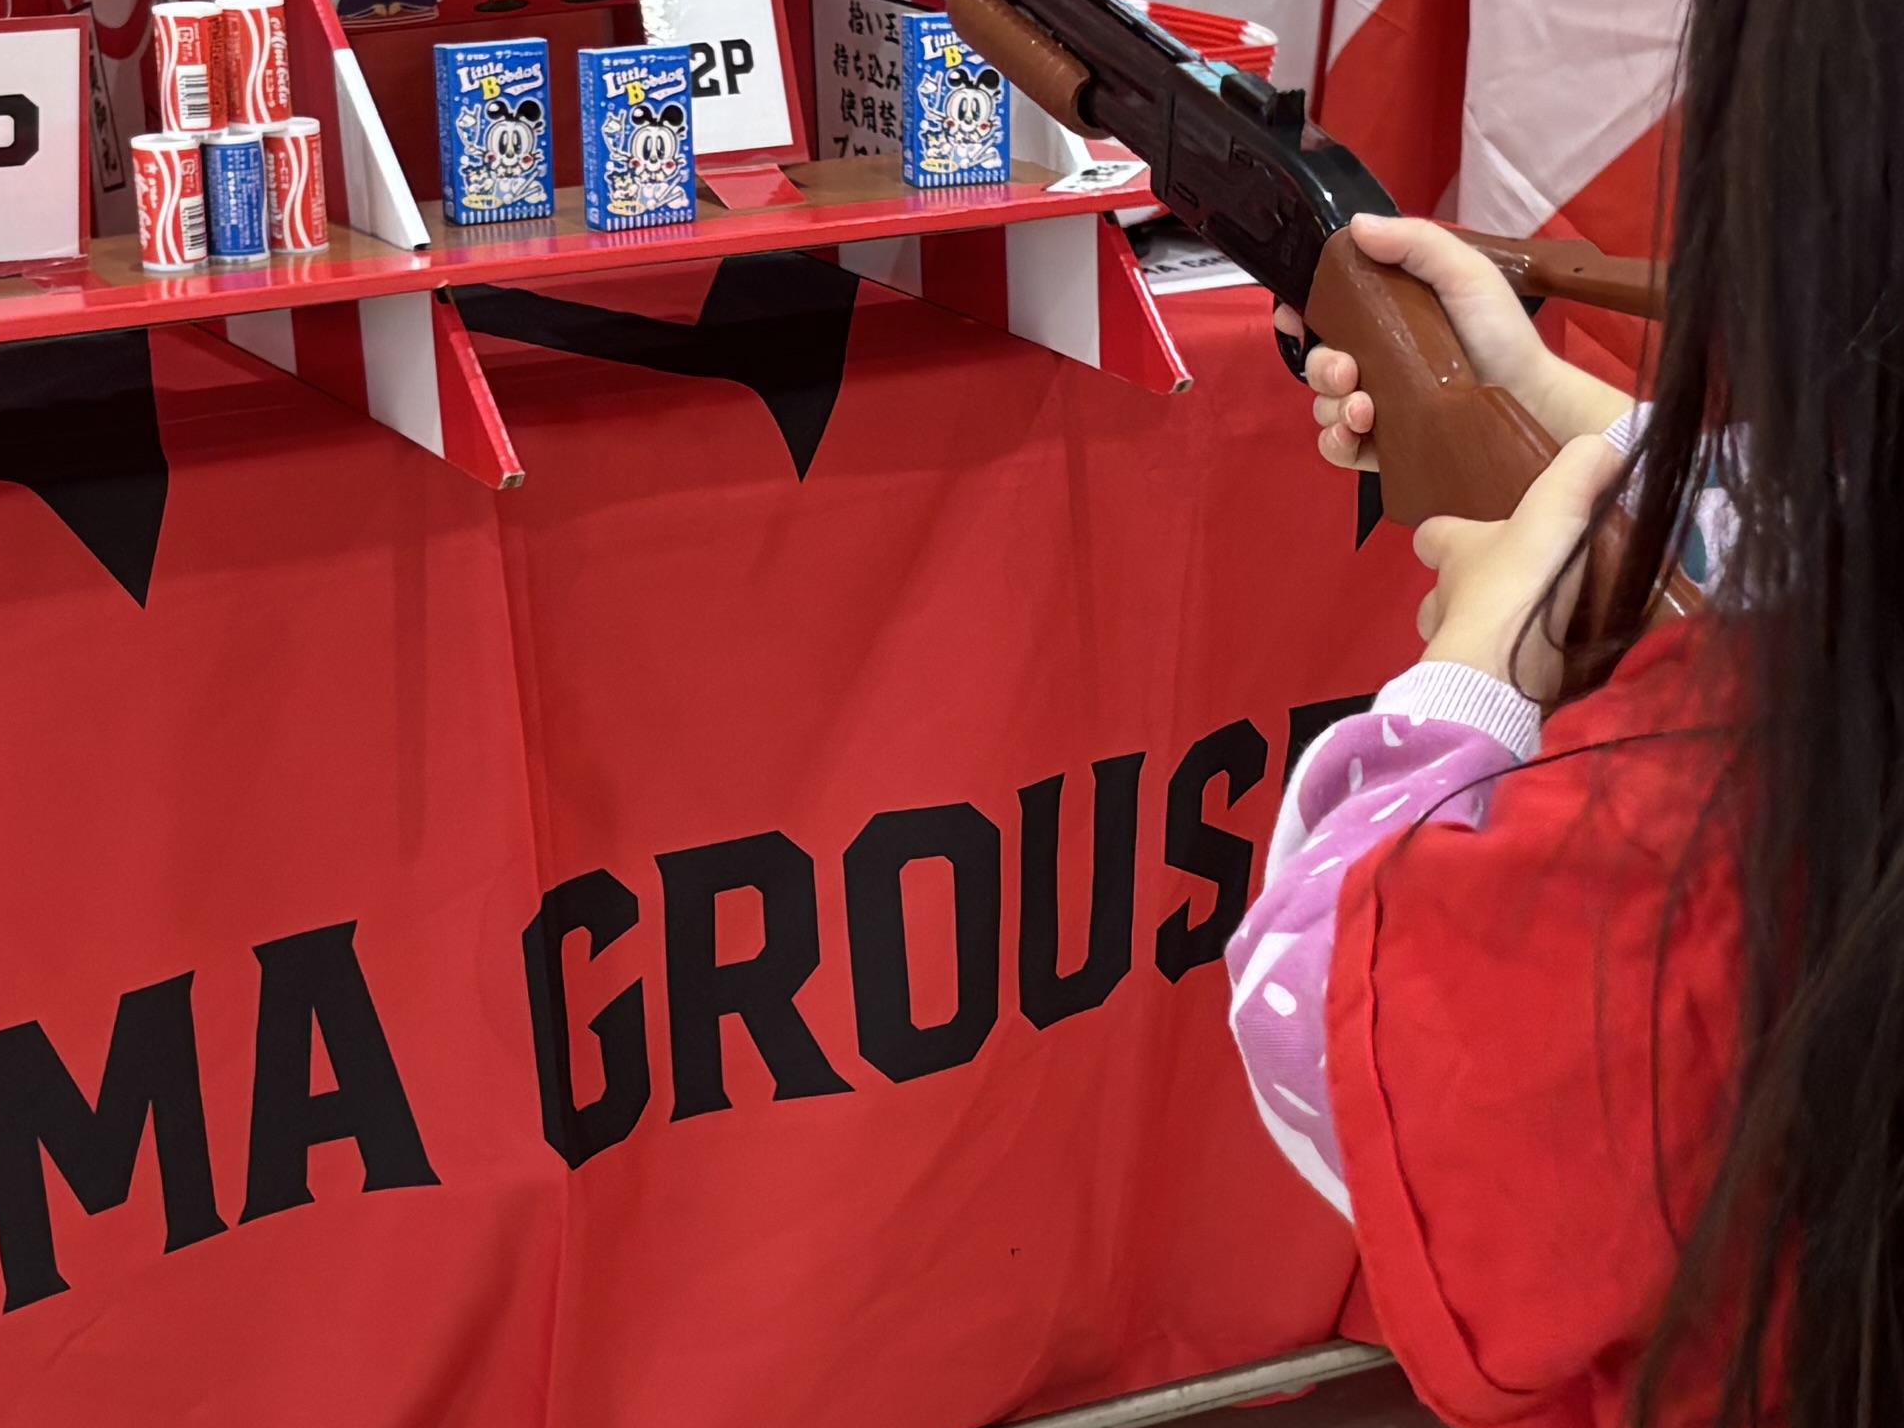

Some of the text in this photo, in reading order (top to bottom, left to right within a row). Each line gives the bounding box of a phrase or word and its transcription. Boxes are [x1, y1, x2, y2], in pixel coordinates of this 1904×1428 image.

[456, 62, 504, 93] Little
[602, 66, 648, 98] Little
[690, 38, 754, 98] 2P
[841, 88, 902, 142] 使用禁
